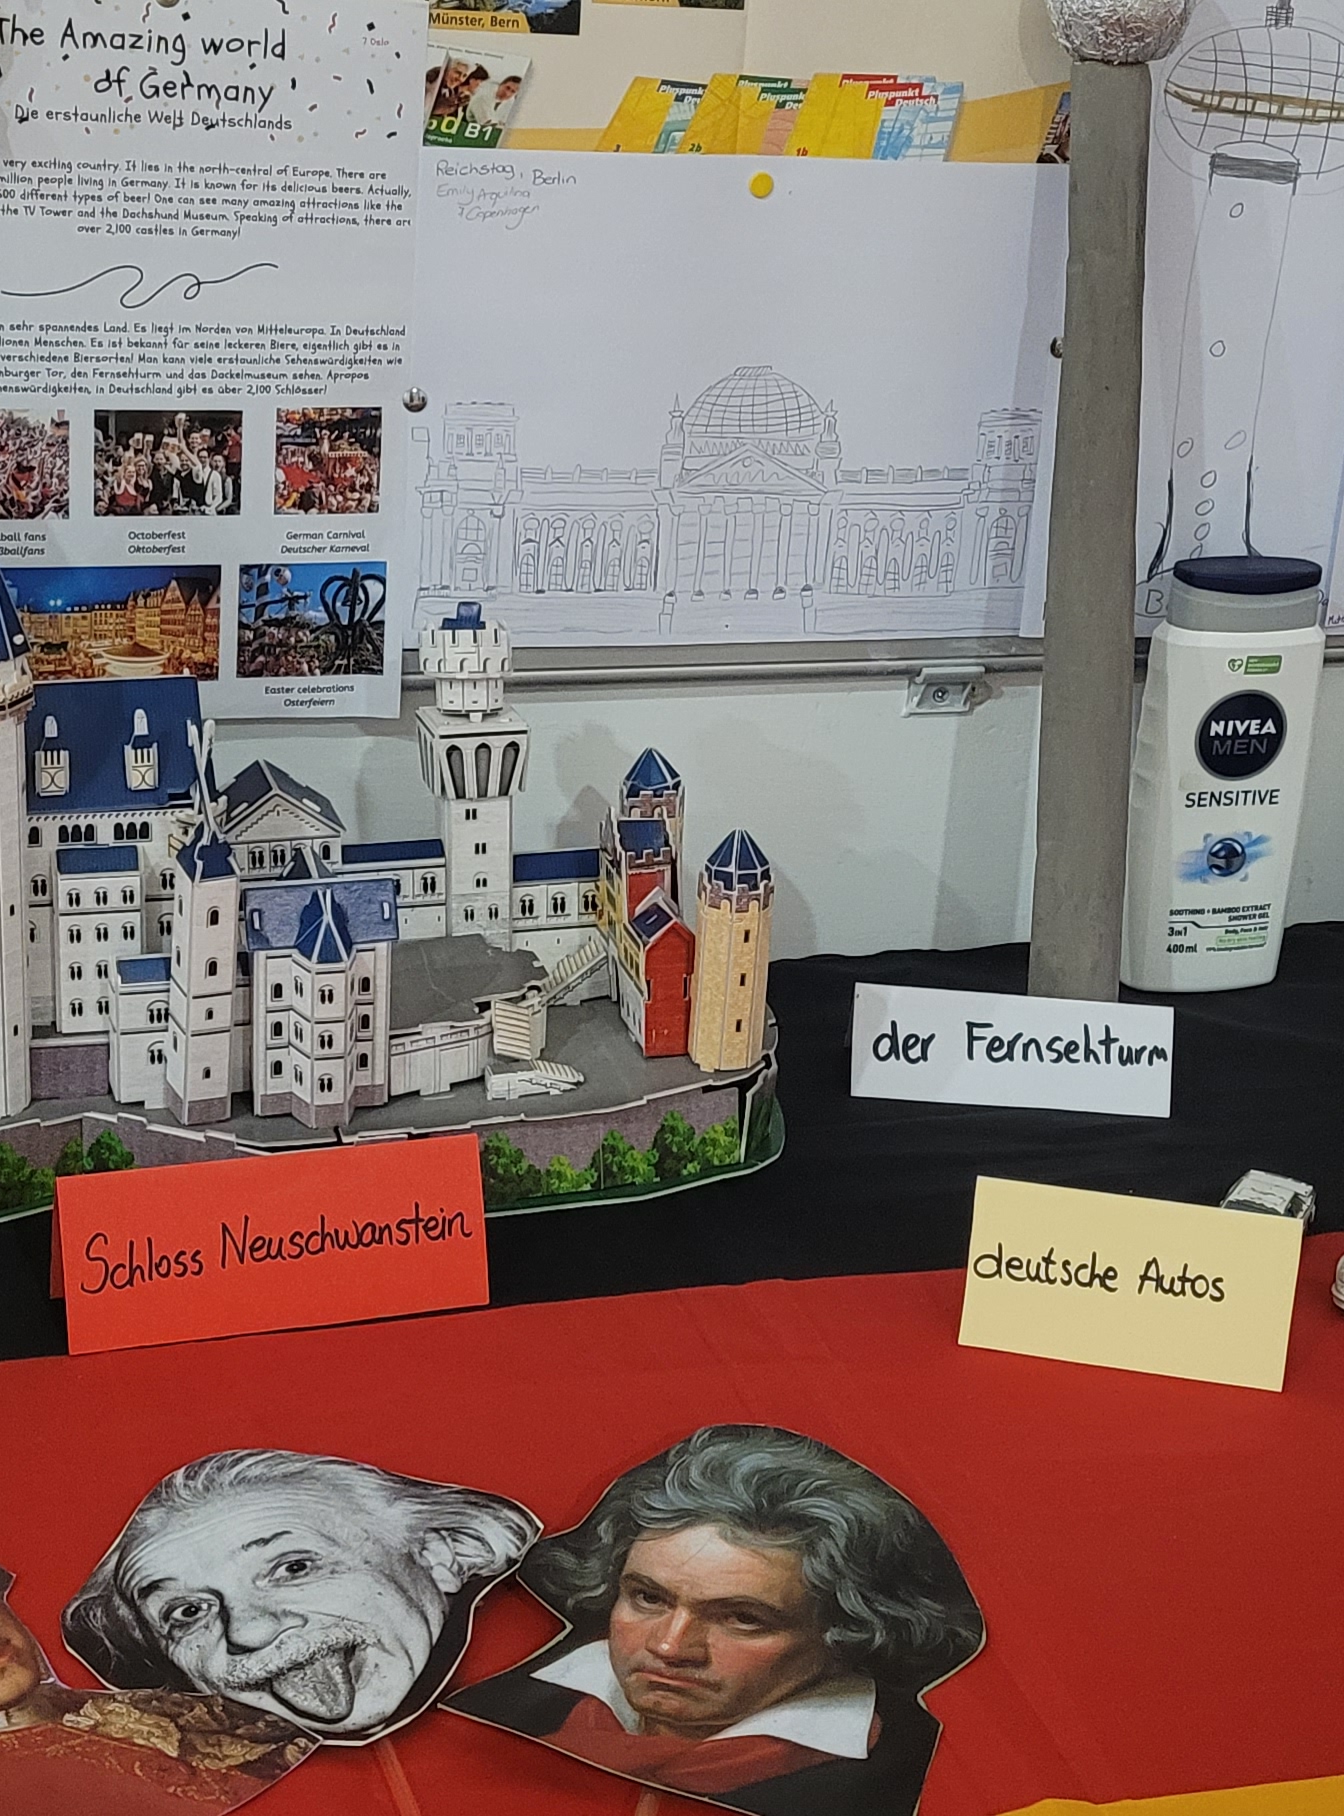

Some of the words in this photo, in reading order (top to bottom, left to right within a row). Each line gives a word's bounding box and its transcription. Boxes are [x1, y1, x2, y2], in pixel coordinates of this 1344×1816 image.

[428, 12, 485, 28] Münster,
[490, 16, 520, 29] Bern
[60, 17, 186, 66] Amazing
[201, 28, 286, 61] world
[94, 65, 131, 98] of
[139, 68, 274, 113] Germany
[867, 88, 920, 101] Pluspunkt
[895, 97, 937, 108] Deutsch
[14, 103, 39, 123] Die
[46, 105, 142, 124] erstaunliche
[148, 109, 184, 128] Welt
[191, 111, 293, 130] Deutschlands
[464, 123, 493, 141] B1
[532, 169, 577, 185] Berlin
[77, 225, 101, 234] over
[105, 223, 132, 235] 2,100
[135, 224, 174, 236] castles
[179, 225, 187, 236] in
[128, 531, 186, 541] Octoberfest
[286, 531, 323, 540] German
[326, 530, 365, 540] Carnival
[128, 544, 186, 555] Oktoberfest
[281, 545, 327, 554] Deutscher
[329, 544, 370, 553] Karneval
[264, 686, 295, 695] Easter
[296, 684, 355, 694] celebrations
[283, 698, 336, 709] Osterfeiern
[1209, 718, 1276, 736] NIVEA
[1212, 738, 1267, 755] MEN
[1184, 789, 1280, 808] SENSITIVE
[1242, 903, 1271, 913] EXTRACT
[1258, 912, 1269, 920] GEL
[872, 1019, 936, 1065] der
[964, 1020, 1169, 1067] Fernsehturm
[81, 1232, 204, 1294] Schloss
[220, 1202, 474, 1269] Neuschwanstein
[972, 1242, 1119, 1294] deutsche
[1137, 1257, 1226, 1302] Autos
